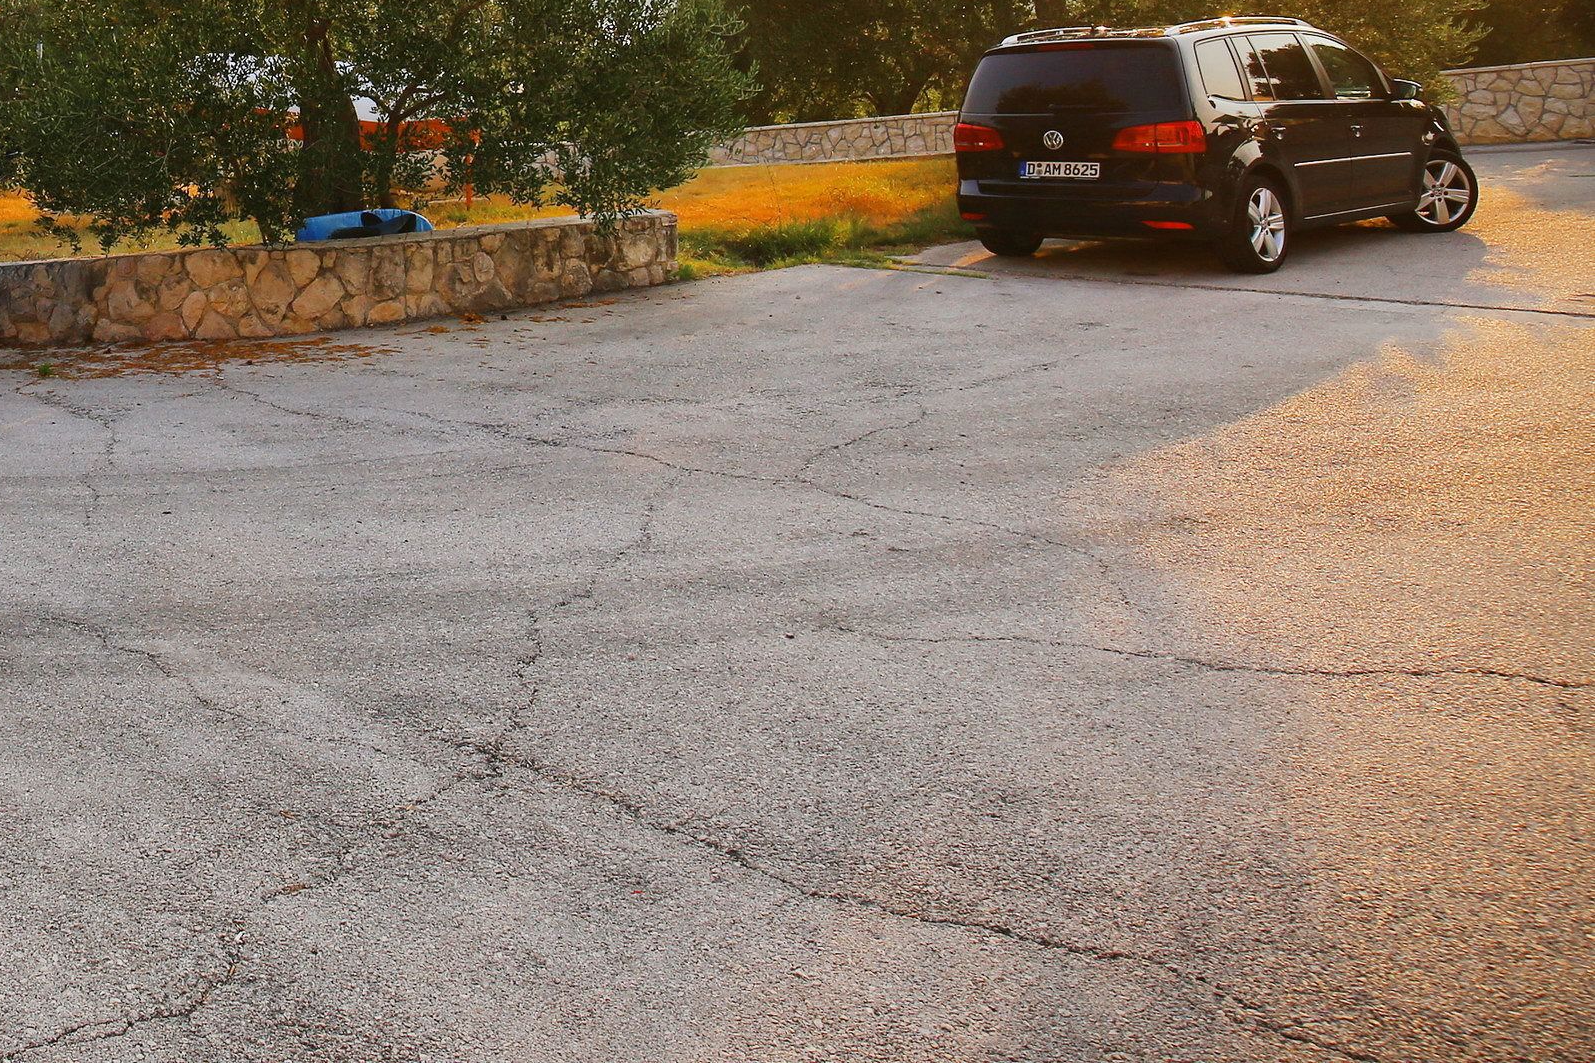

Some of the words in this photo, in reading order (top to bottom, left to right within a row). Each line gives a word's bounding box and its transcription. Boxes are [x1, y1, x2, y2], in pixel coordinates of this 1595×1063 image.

[1027, 163, 1036, 175] D
[1044, 163, 1061, 175] AM
[1063, 163, 1099, 176] 8625
